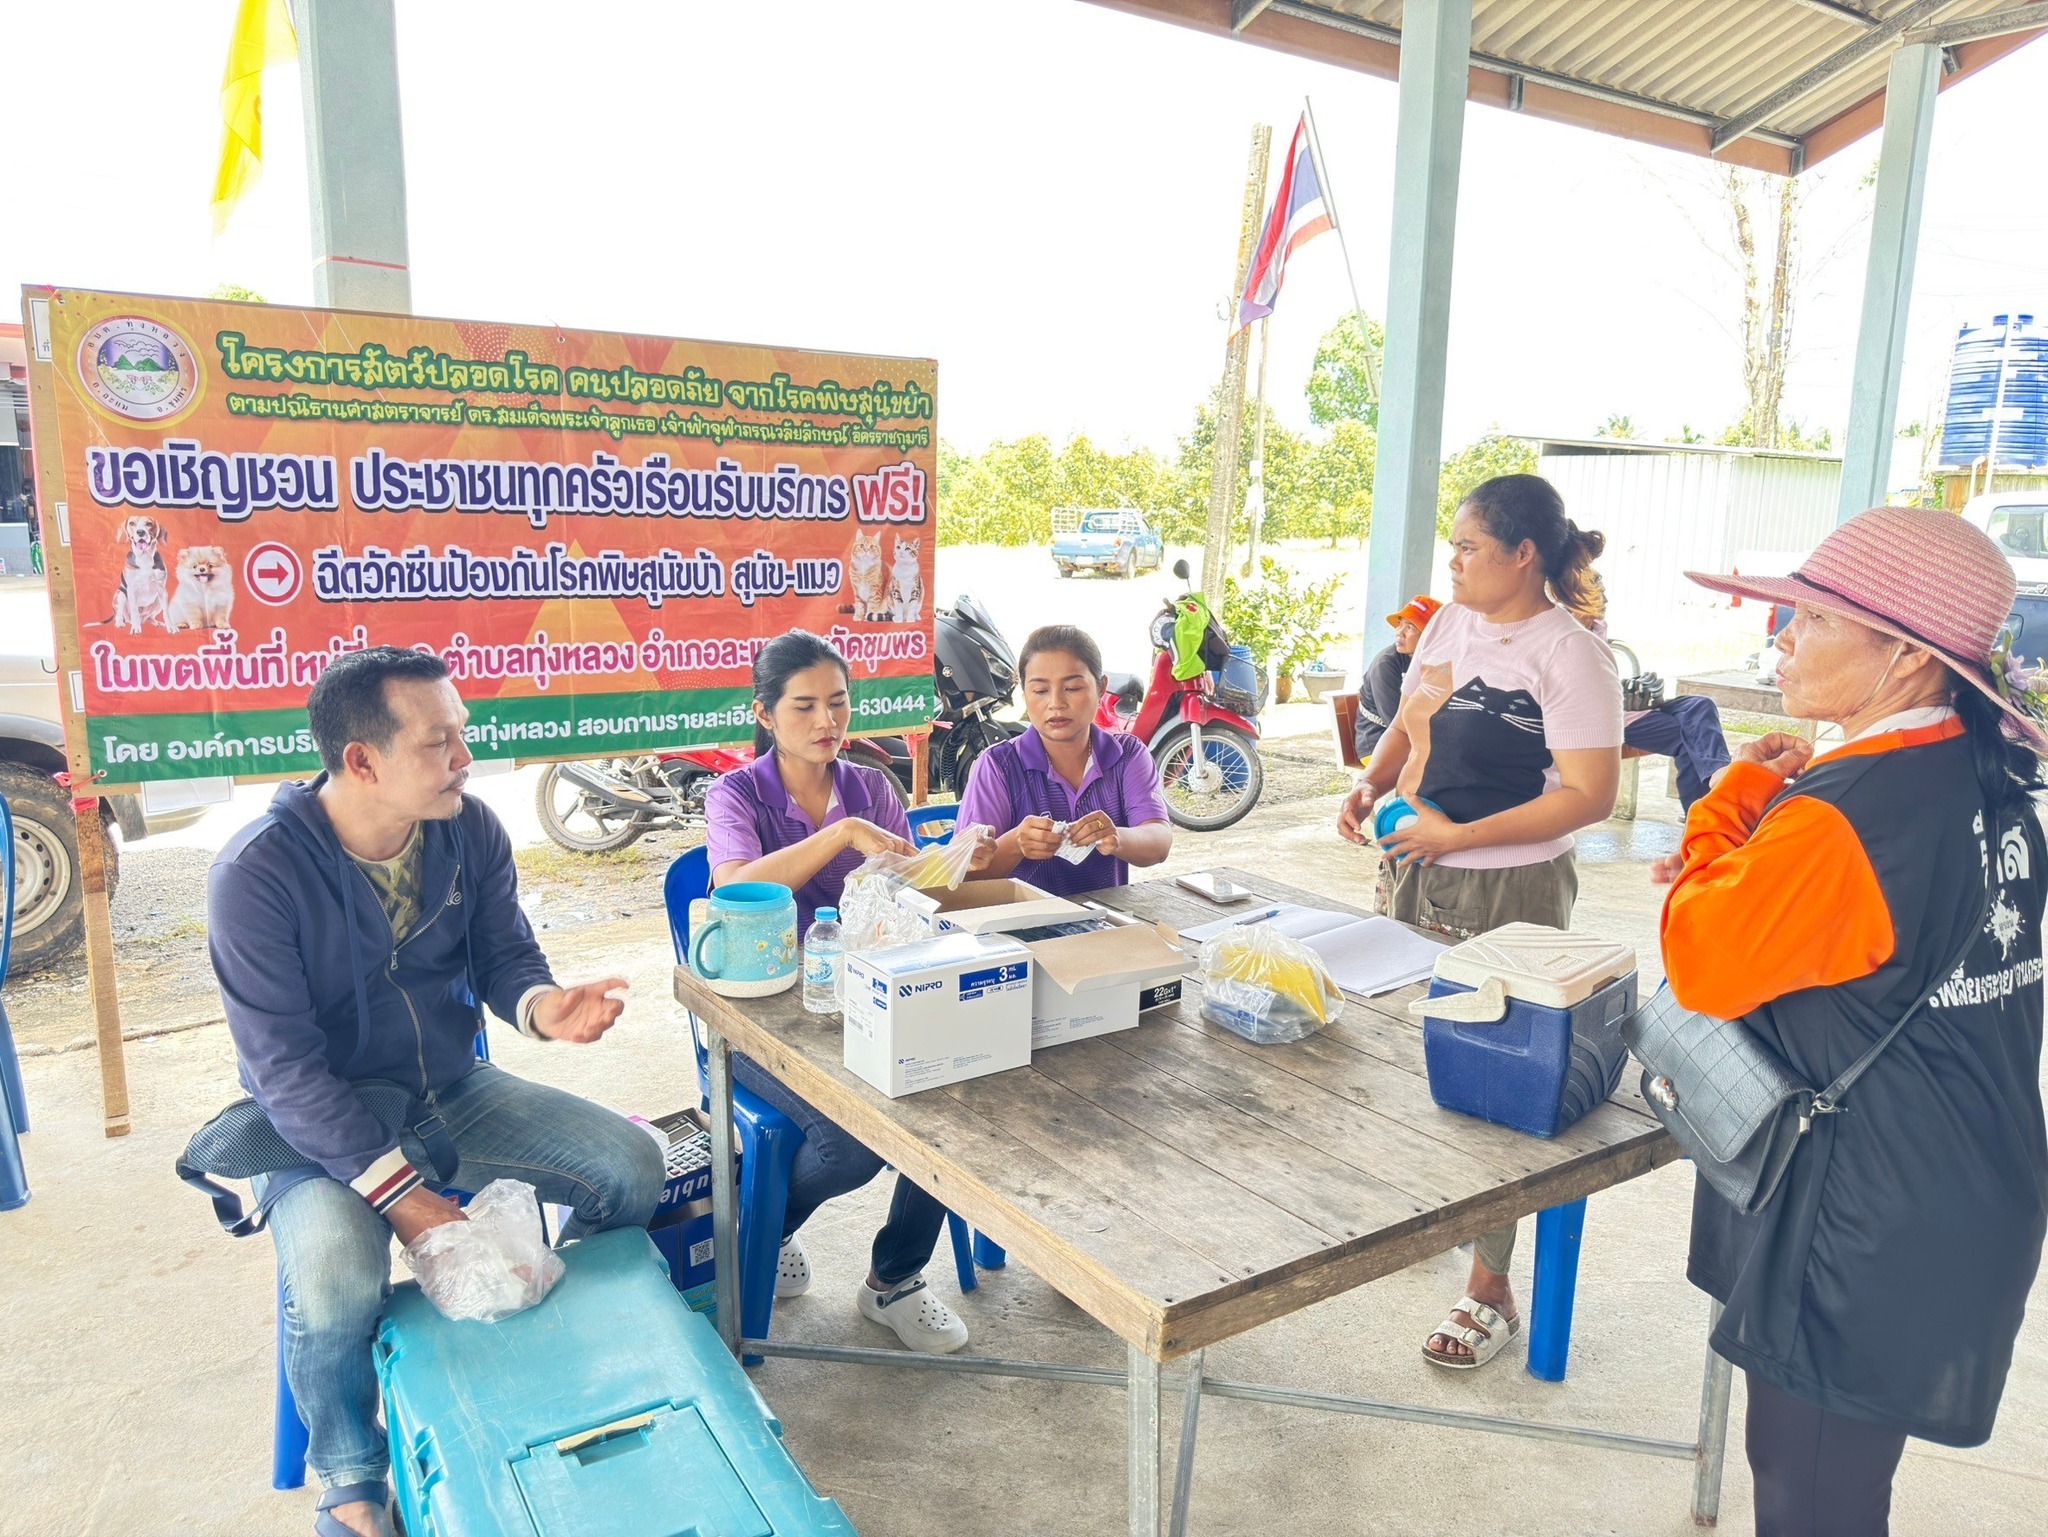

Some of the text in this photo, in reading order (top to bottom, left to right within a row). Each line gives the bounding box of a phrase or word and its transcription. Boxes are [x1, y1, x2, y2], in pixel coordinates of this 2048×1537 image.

[222, 337, 930, 425] โครงการสัตว์ปลอดโรค คนปลอดภัย จากโรคพิษสุนัขบ้า
[229, 395, 465, 422] ตามปณิธานศาสตราจารย์
[852, 426, 929, 451] อัครราชกุมารี
[89, 442, 921, 522] ขอเชิญชวน ประชาชนทุกครัวเรือนรับบริการ ฟรี!
[316, 546, 841, 604] ฉีดวัคซีนป้องกันโรคพิษสุนัขบ้า สุนัข-แมว
[96, 630, 284, 688] ในเขตพื้นที่
[444, 632, 633, 686] ตำบลทุ่งหลวง
[104, 738, 158, 763] โดย
[578, 703, 757, 736] สอบถามรายละเอีย
[851, 694, 926, 716] -630444
[915, 980, 943, 993] NIPRO
[999, 966, 1008, 982] 3
[660, 1172, 710, 1204] uble
